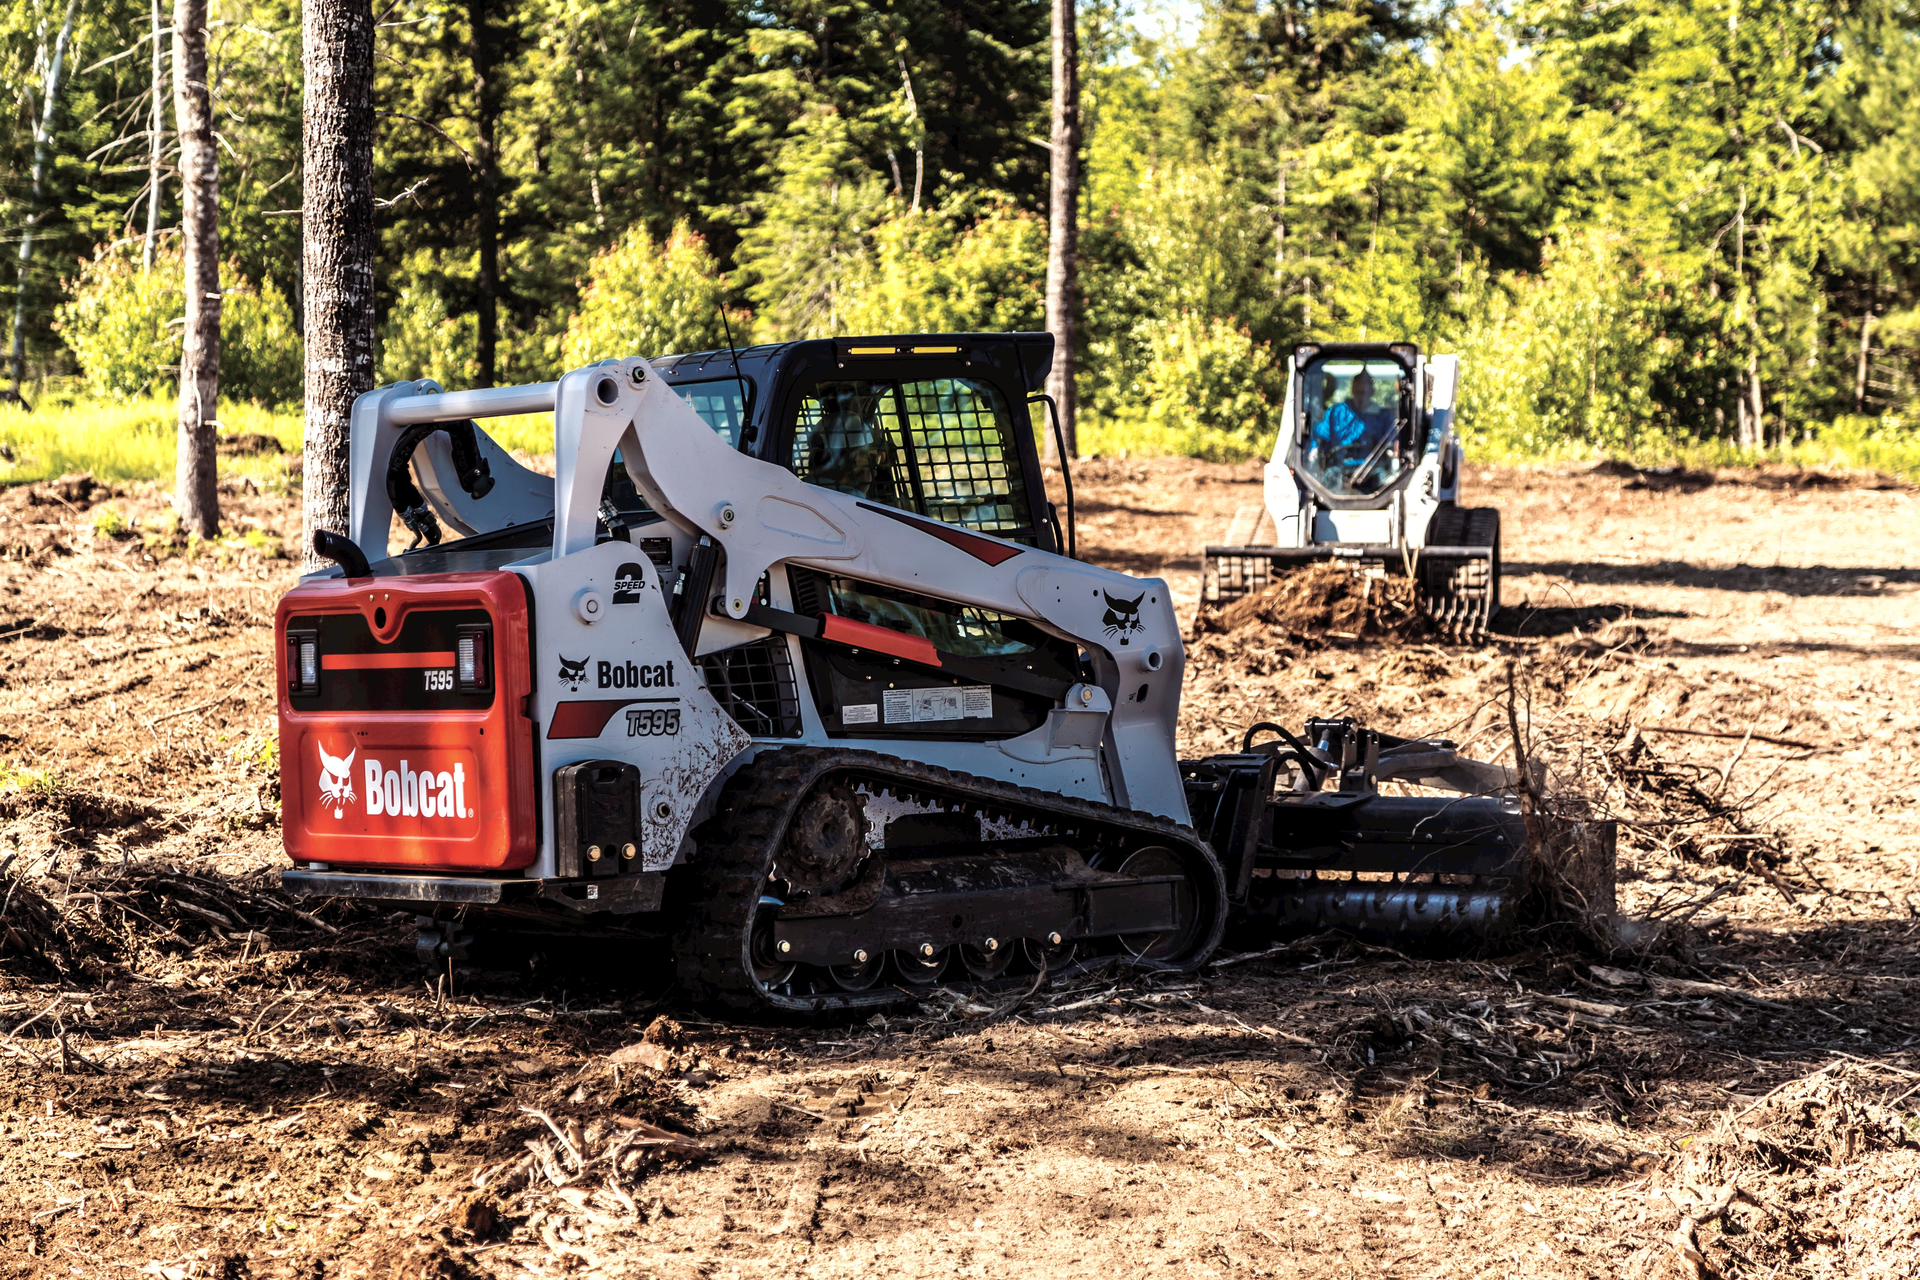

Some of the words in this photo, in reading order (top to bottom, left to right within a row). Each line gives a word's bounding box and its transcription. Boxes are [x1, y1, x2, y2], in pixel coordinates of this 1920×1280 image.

[612, 562, 643, 605] 2
[614, 581, 646, 590] SPEED
[424, 670, 454, 691] T595
[597, 660, 675, 689] Bobcat
[625, 709, 680, 737] T595
[364, 759, 467, 819] Bobcat
